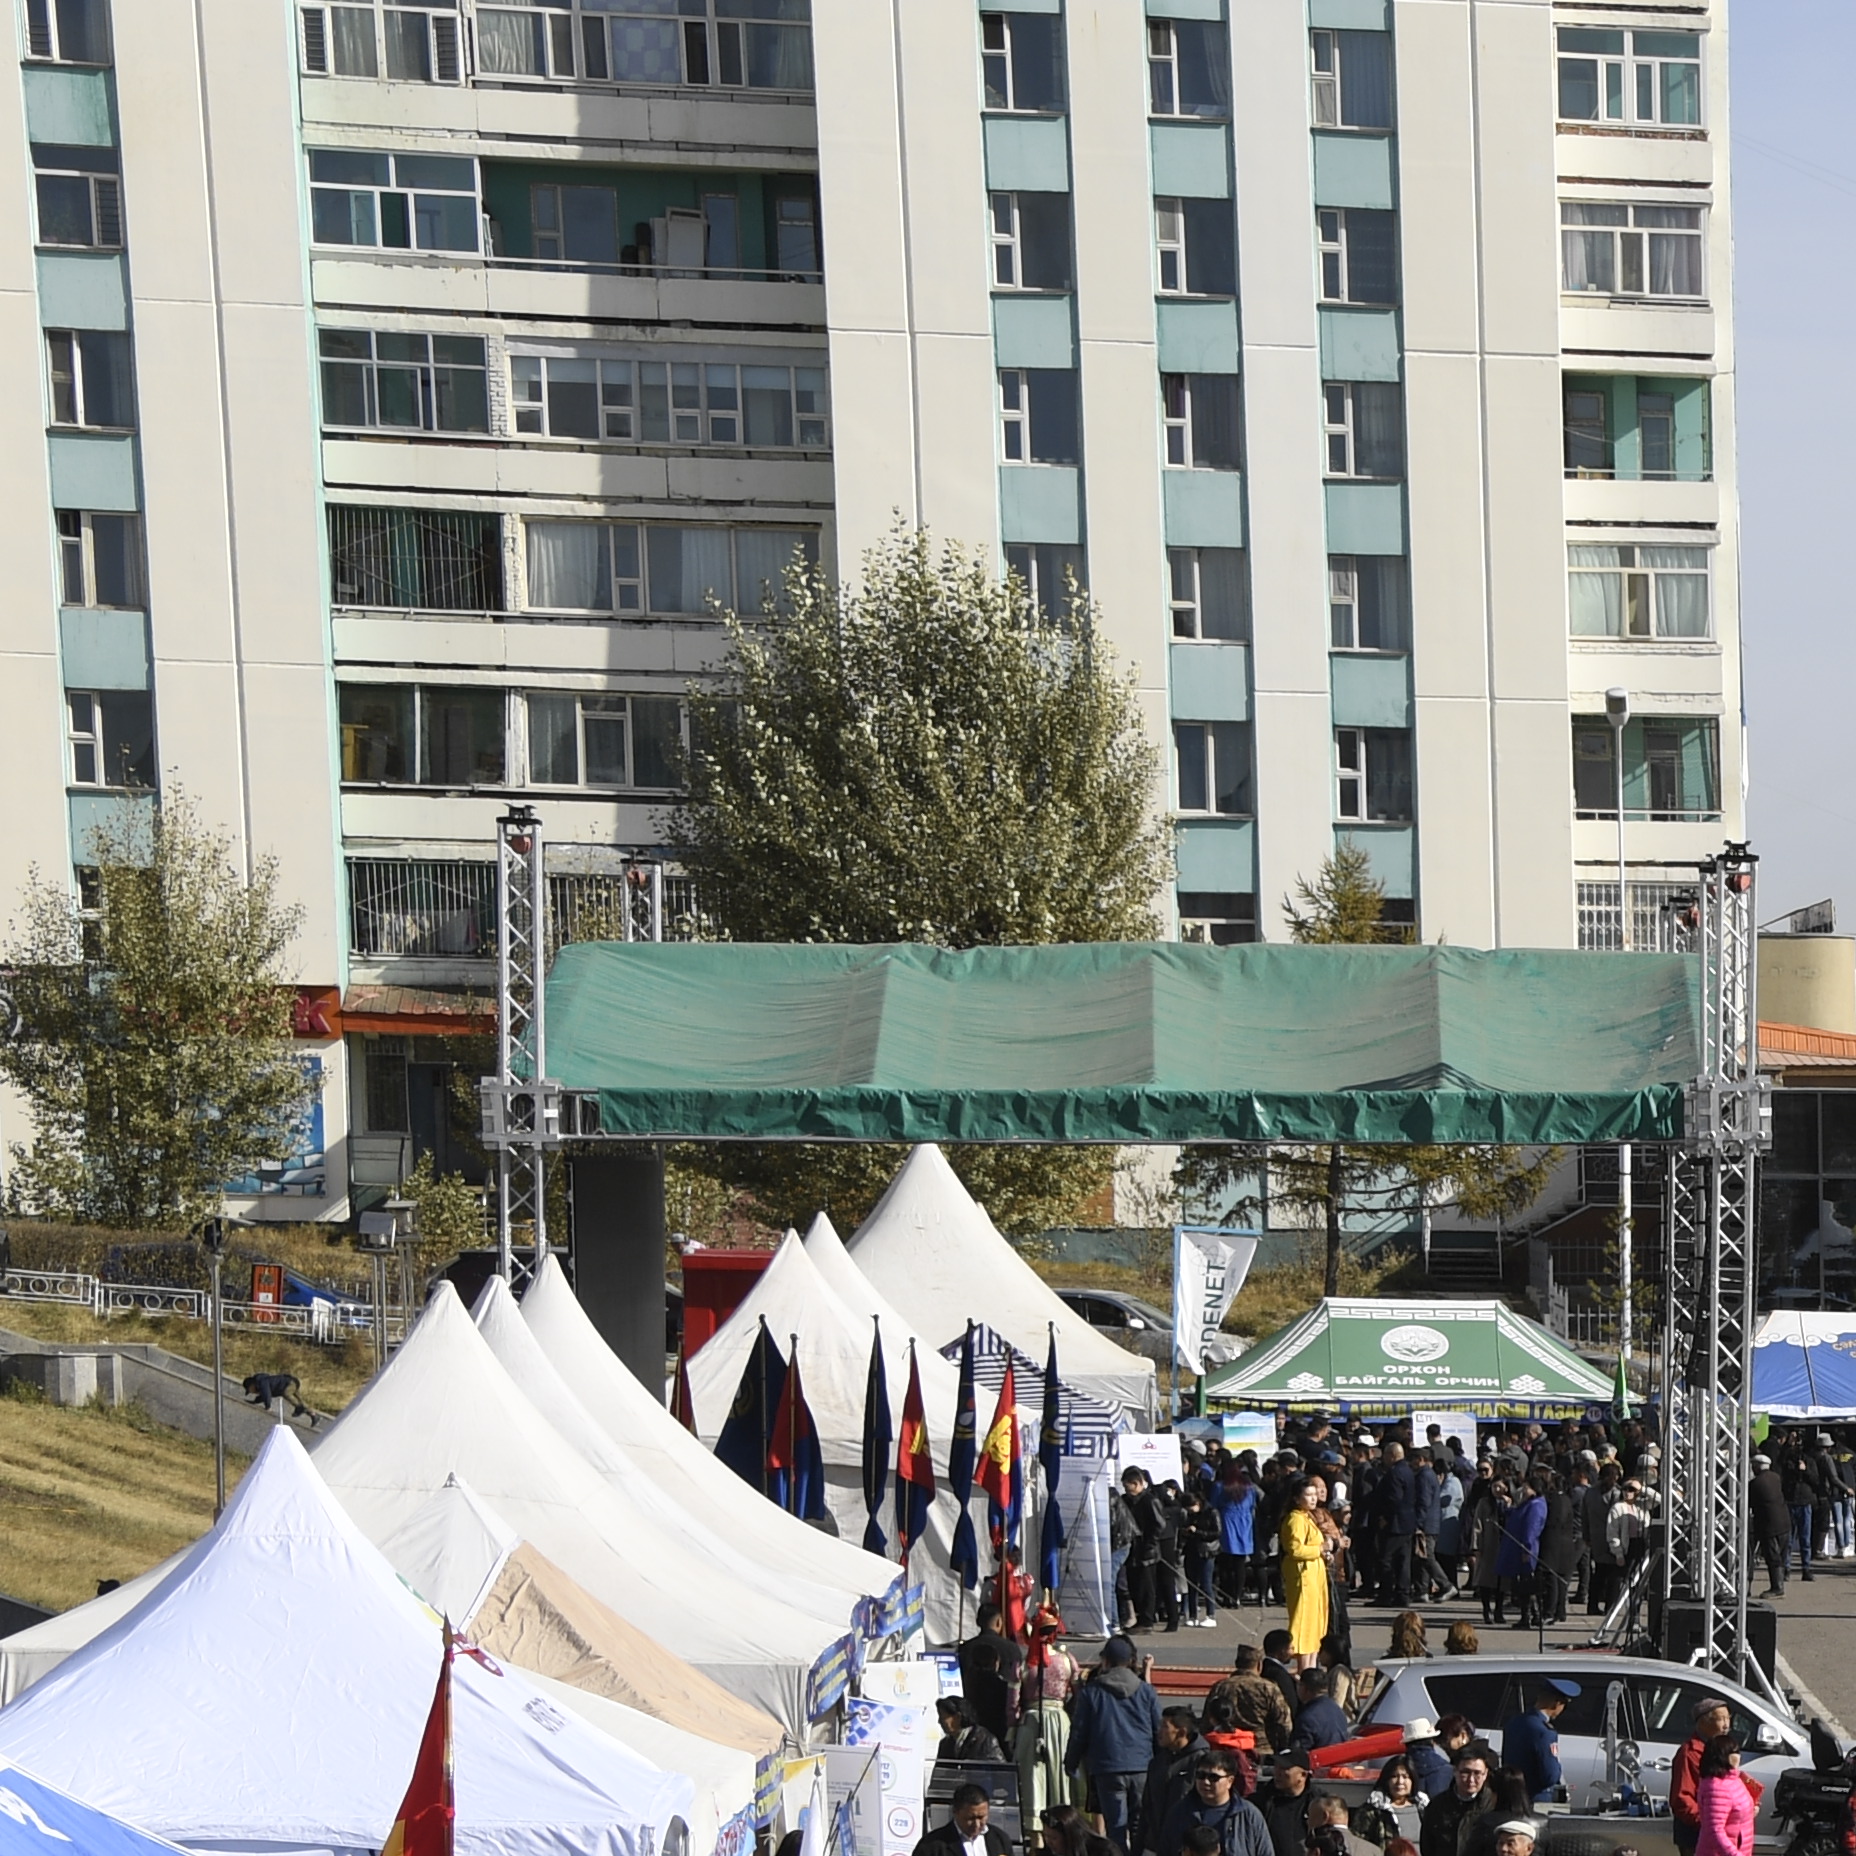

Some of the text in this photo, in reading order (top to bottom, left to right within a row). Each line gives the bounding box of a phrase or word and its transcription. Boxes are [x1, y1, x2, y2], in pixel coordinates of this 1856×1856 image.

[1383, 1365, 1450, 1375] ОРХОН
[1335, 1374, 1500, 1386] БАЙГАЛЬ ОРЧИН
[1534, 1405, 1586, 1421] ГАЗАР
